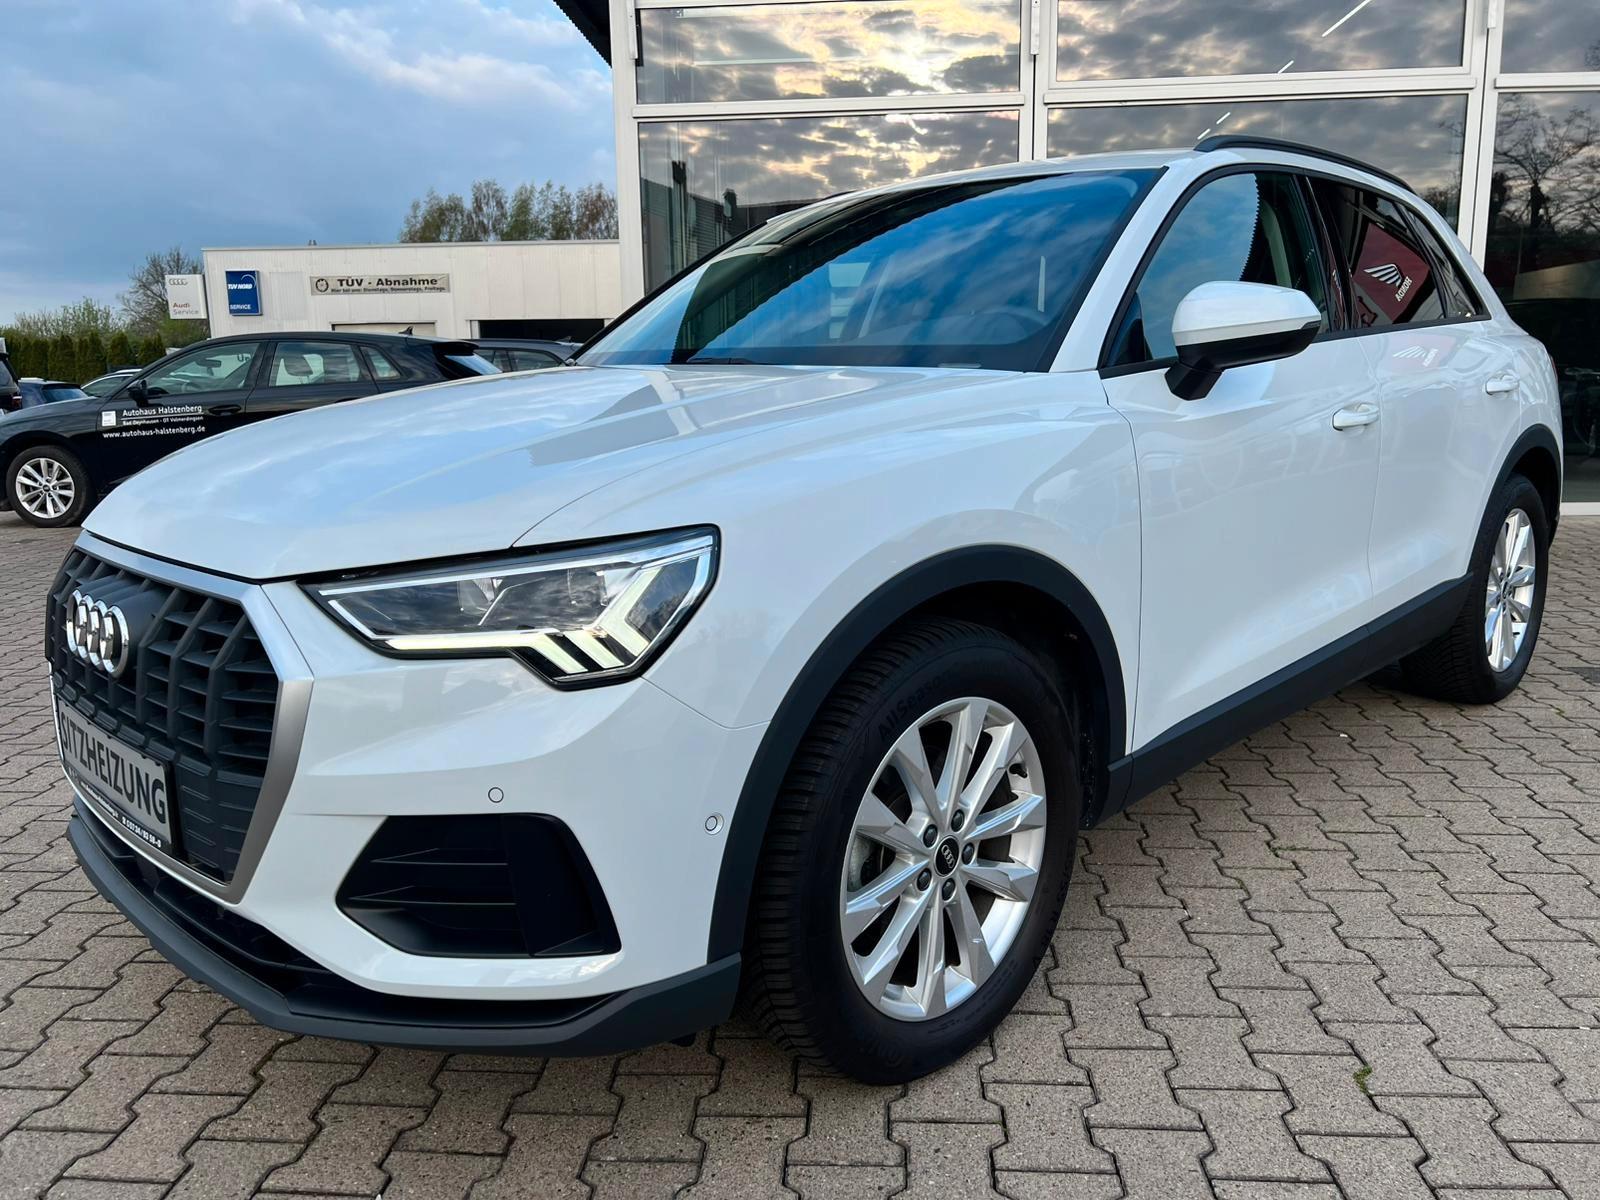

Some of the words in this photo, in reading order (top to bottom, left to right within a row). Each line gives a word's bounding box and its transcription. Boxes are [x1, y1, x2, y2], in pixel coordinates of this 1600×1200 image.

[337, 276, 363, 287] TÜV
[376, 277, 438, 287] Abnahme
[122, 408, 157, 417] Autohaus
[158, 405, 203, 415] Halstenberg
[102, 425, 206, 439] www.autohaus-halstenberg.de
[60, 711, 167, 825] SITZHEIZUNG
